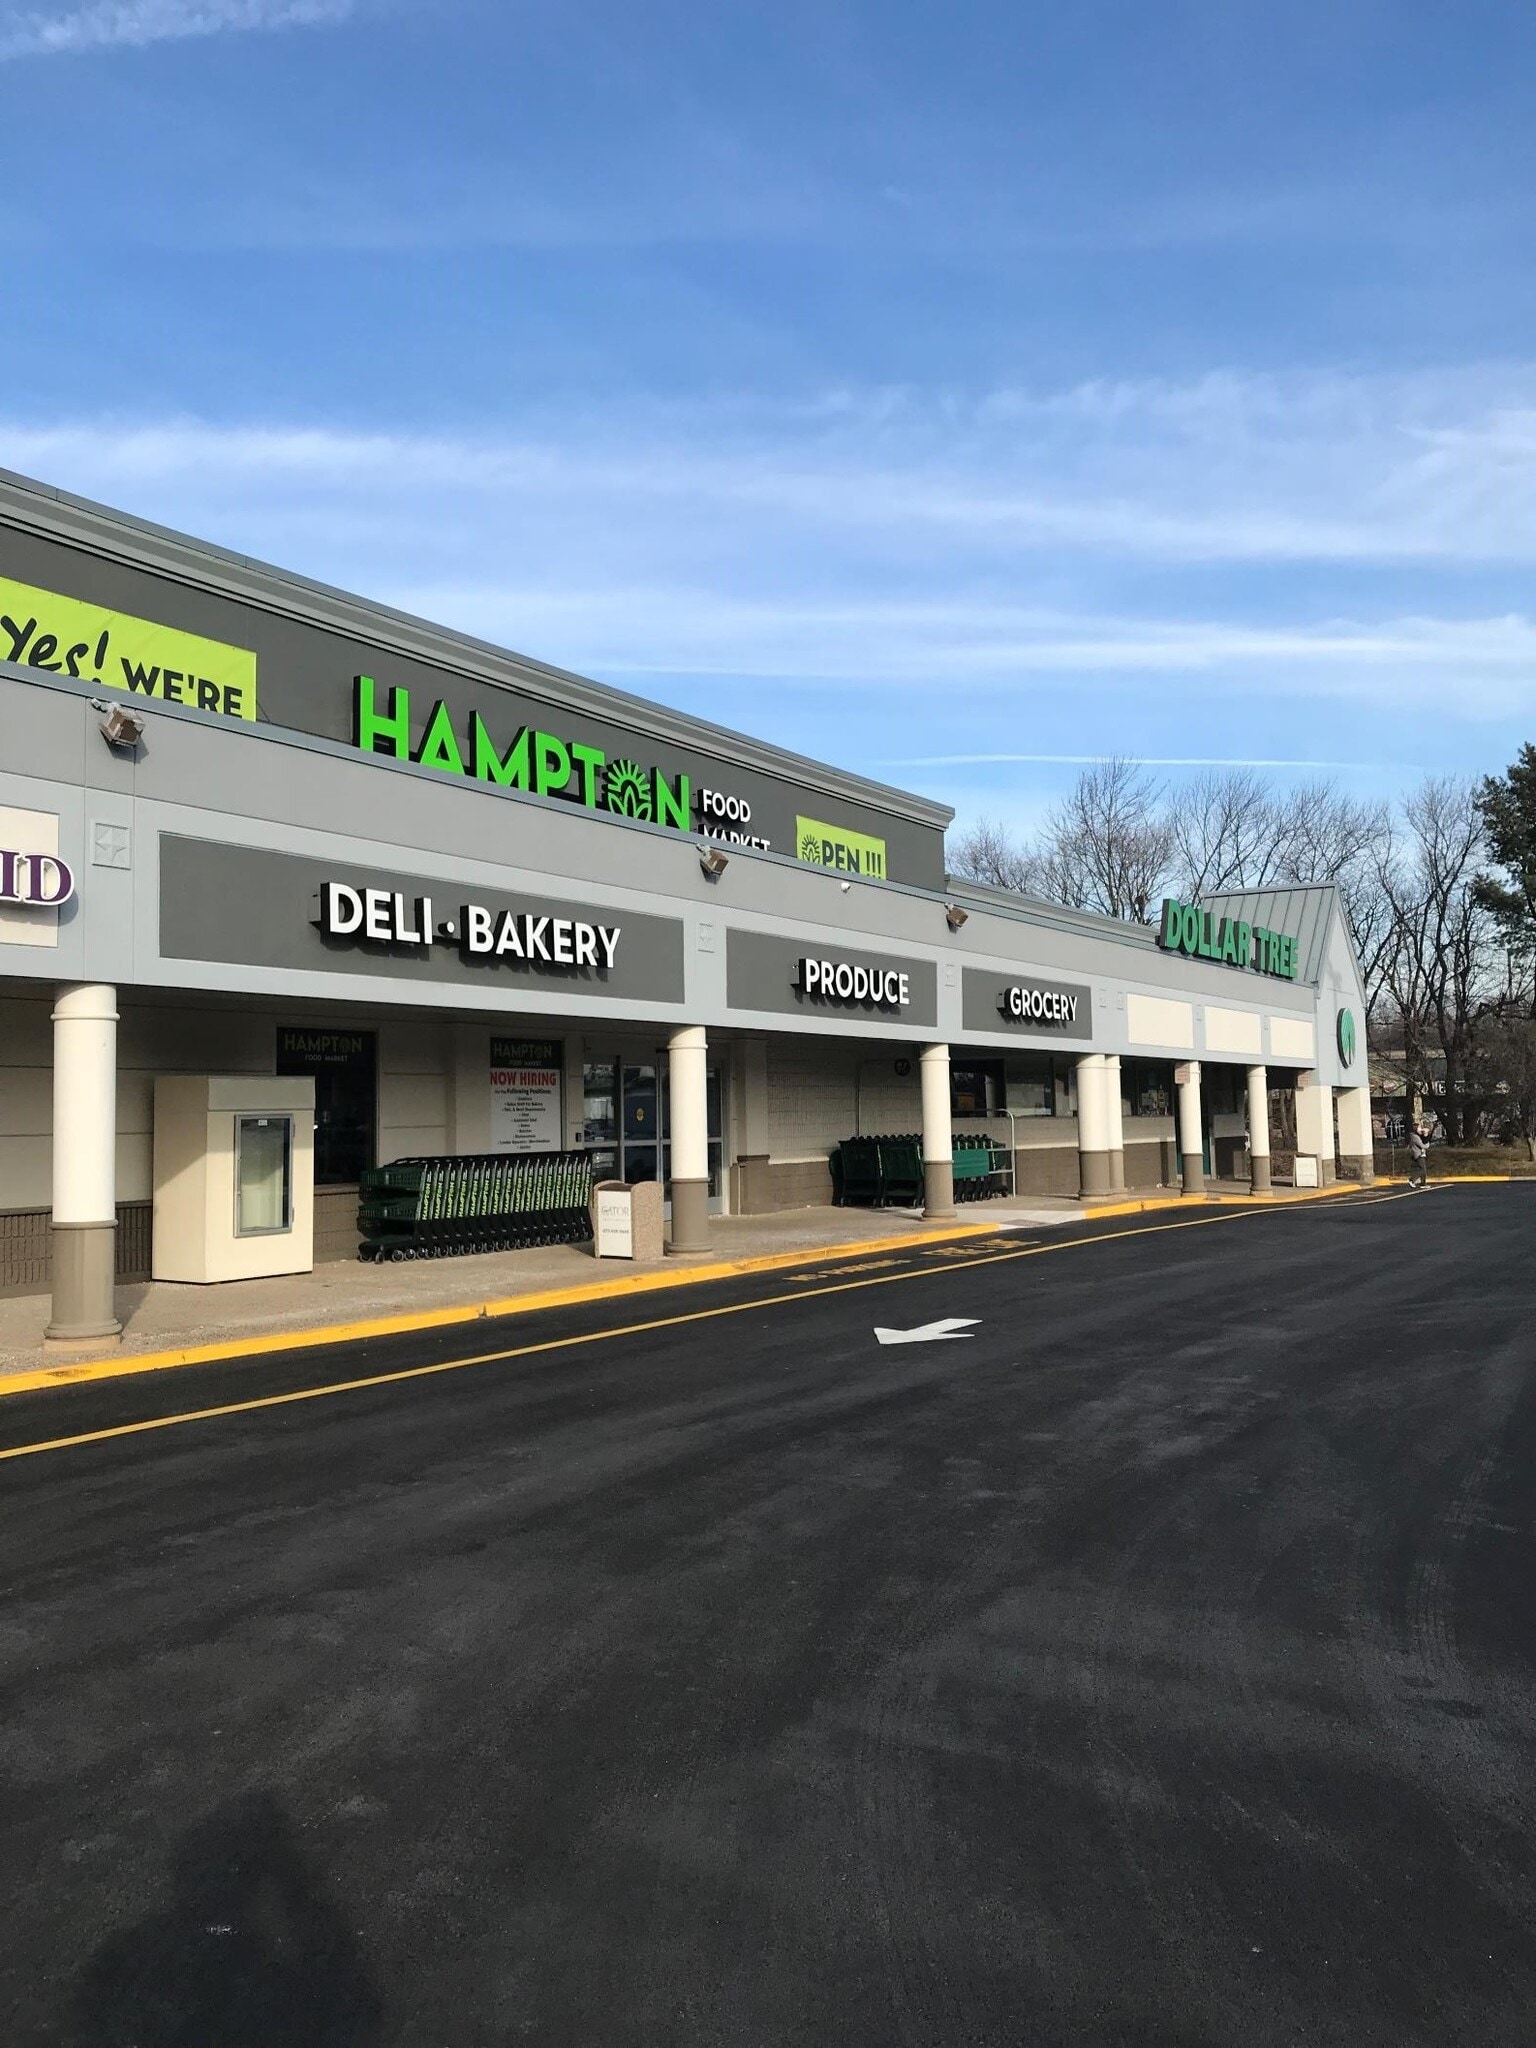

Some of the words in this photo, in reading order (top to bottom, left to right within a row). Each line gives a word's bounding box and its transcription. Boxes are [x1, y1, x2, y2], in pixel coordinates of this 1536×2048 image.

[0, 614, 110, 683] Yes!
[121, 657, 243, 719] WE'RE
[358, 675, 690, 832] HAMPTON
[703, 789, 751, 823] FOOD
[329, 882, 433, 945] DELI
[468, 904, 621, 968] BAKERY
[1162, 898, 1251, 968] DOLLAR
[1254, 927, 1299, 978] TREE
[805, 959, 910, 1005] PRODUCE
[1009, 986, 1078, 1022] GROCERY
[284, 1033, 362, 1053] HAMPTON
[490, 1071, 516, 1086] NOW
[520, 1071, 557, 1086] HIRING
